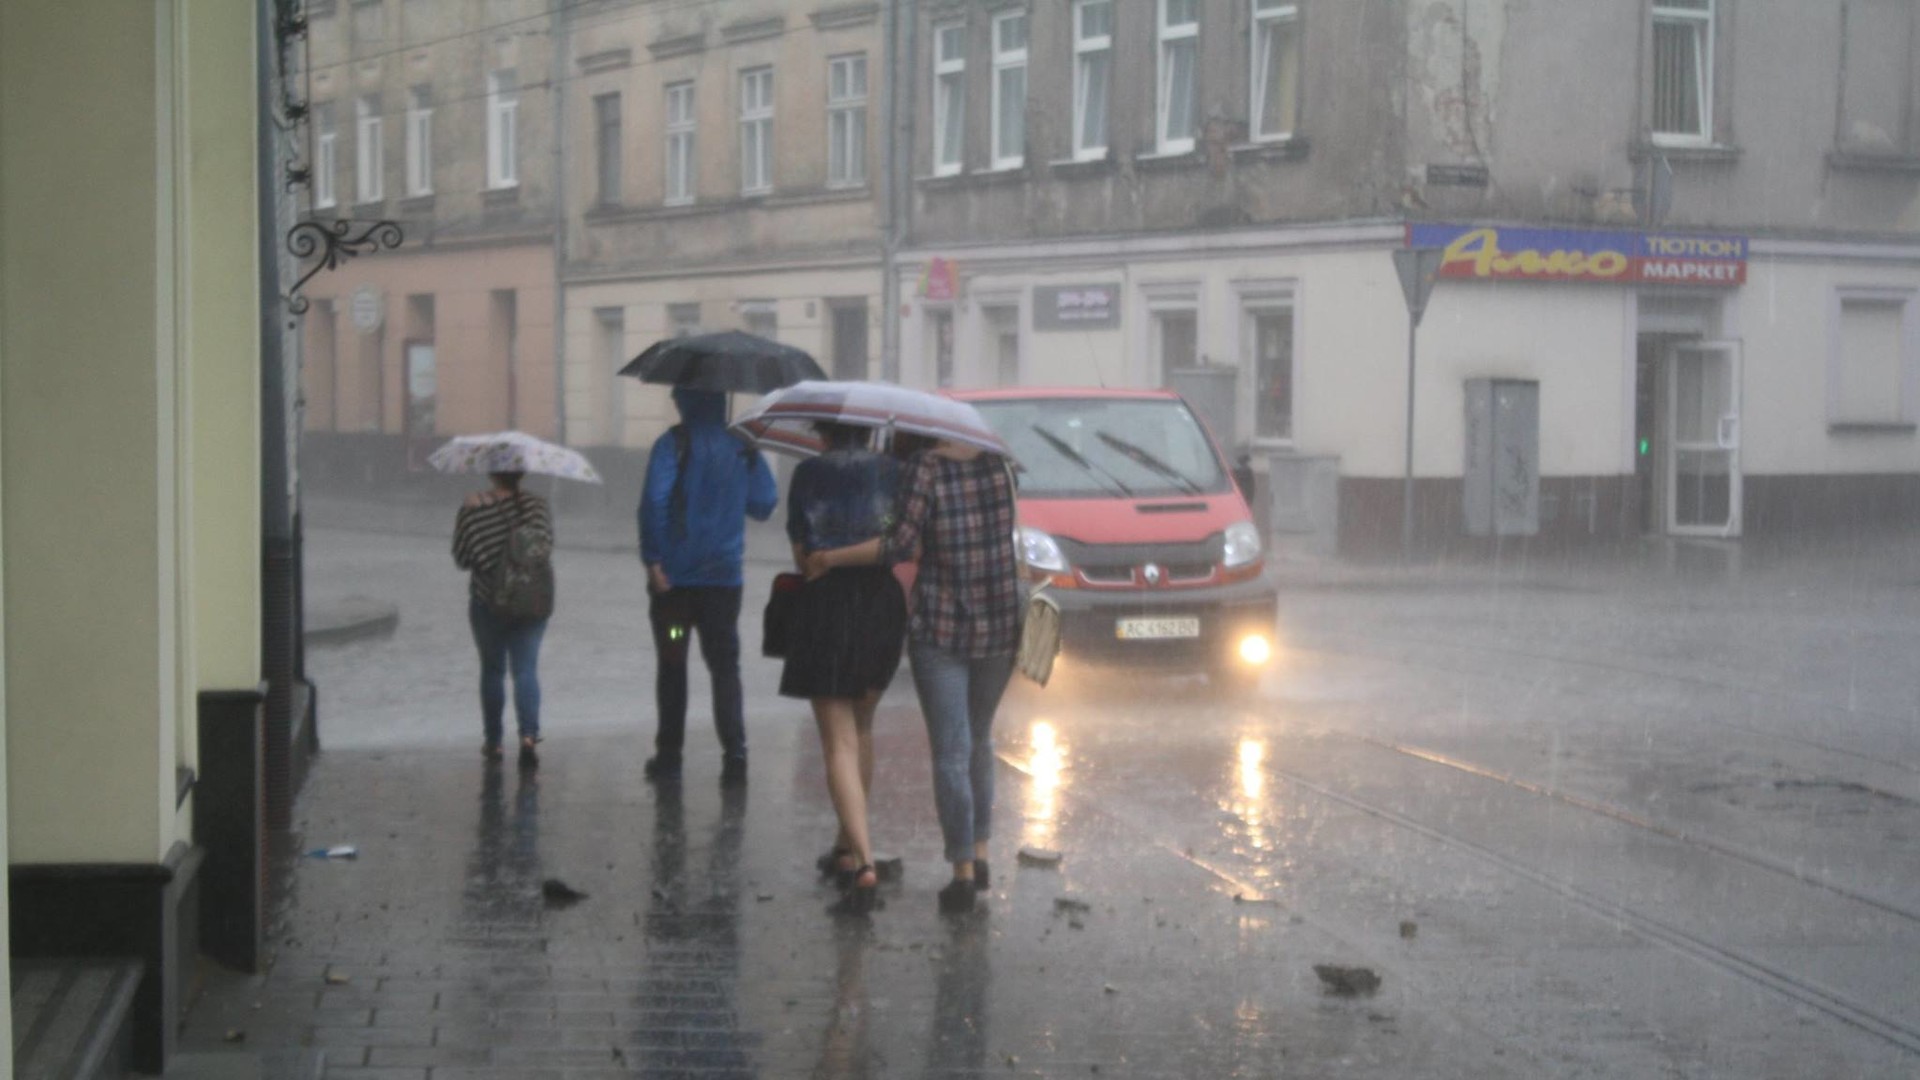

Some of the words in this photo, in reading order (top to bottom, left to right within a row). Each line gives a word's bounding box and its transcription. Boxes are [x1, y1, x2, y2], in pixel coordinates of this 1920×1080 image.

[1441, 228, 1628, 277] Алко
[1647, 236, 1742, 257] ТЮТЮН
[1643, 262, 1738, 280] МАРКЕТ
